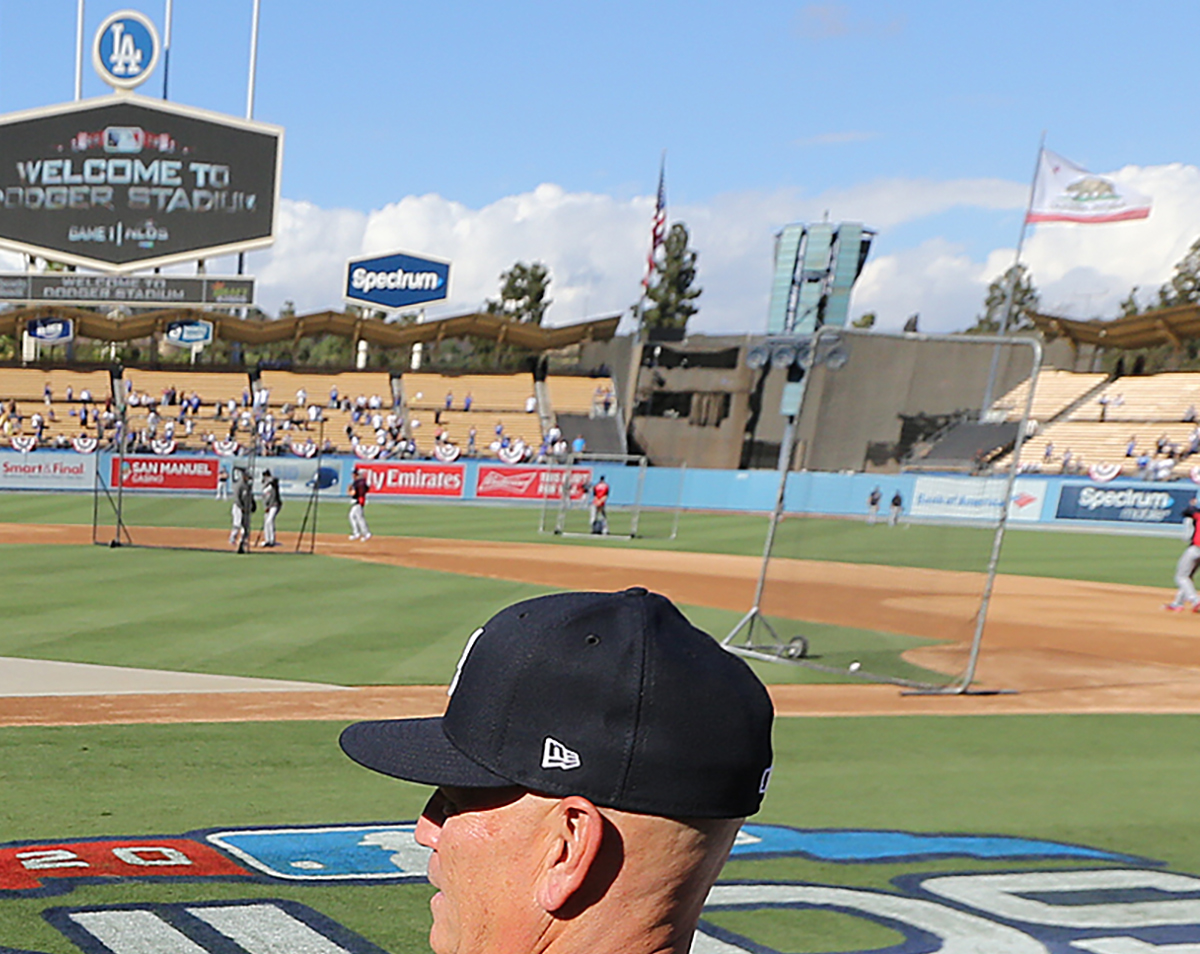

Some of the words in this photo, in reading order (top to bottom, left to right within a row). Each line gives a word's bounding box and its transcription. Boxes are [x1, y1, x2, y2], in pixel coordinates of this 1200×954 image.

[109, 22, 142, 74] LA
[16, 158, 182, 185] WELCOME
[189, 162, 229, 188] TO
[68, 226, 106, 242] GAME
[61, 276, 140, 288] WELCOME
[352, 267, 438, 293] Spectrum
[43, 286, 110, 298] DODGER
[115, 288, 185, 300] STADIUM
[3, 461, 42, 474] Smart
[53, 462, 84, 475] Final
[132, 461, 158, 474] SAN
[160, 462, 212, 476] MANUEL
[386, 468, 462, 489] Emirates
[1079, 487, 1170, 510] Spectrum
